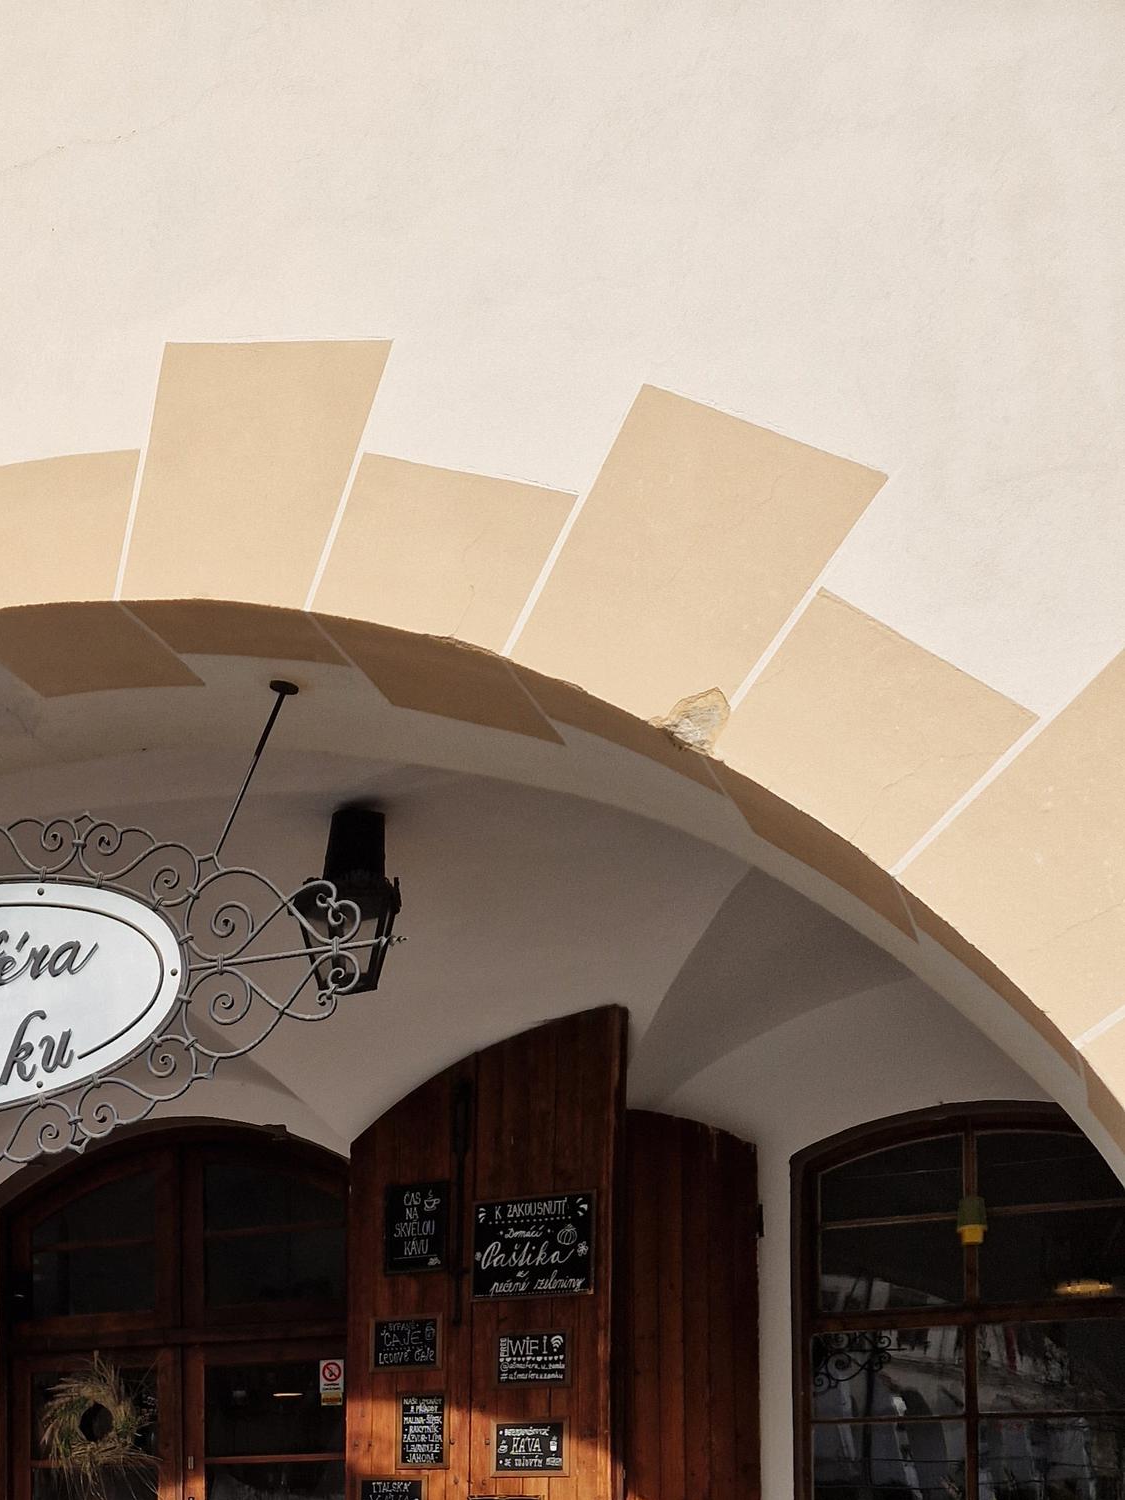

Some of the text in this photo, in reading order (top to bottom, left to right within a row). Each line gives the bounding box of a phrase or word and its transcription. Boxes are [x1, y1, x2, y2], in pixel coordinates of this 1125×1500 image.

[404, 1190, 421, 1206] ČAS
[405, 1207, 419, 1220] NA
[495, 1205, 502, 1220] K
[404, 1237, 429, 1256] KÁVU
[481, 1241, 574, 1270] Paštika
